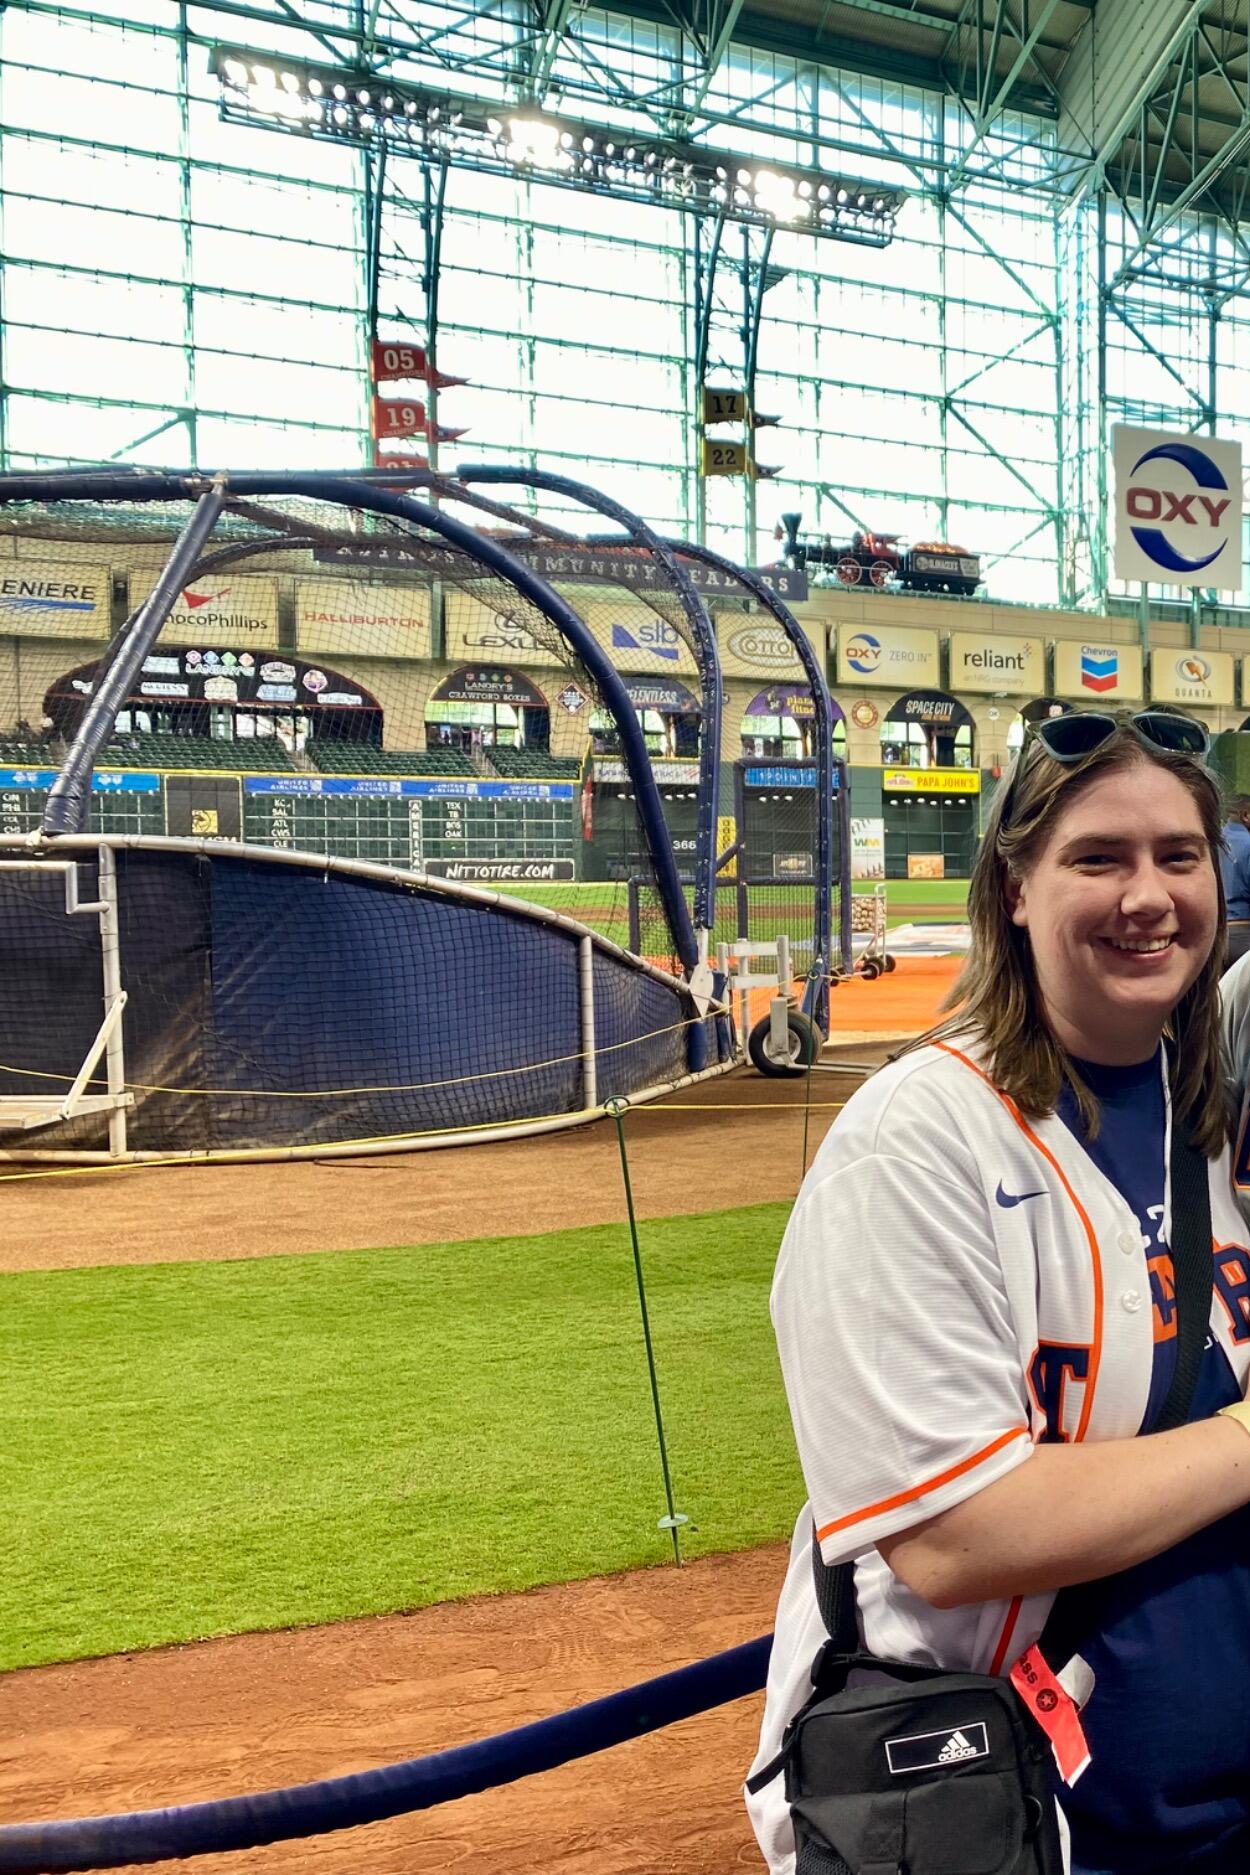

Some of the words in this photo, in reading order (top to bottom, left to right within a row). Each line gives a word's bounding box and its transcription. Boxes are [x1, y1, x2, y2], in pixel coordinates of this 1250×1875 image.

[384, 349, 415, 370] 05
[713, 395, 736, 413] 17
[387, 407, 416, 426] 19
[713, 449, 736, 465] 22
[1126, 487, 1232, 527] OXY
[2, 579, 96, 600] ENIERE
[165, 613, 268, 632] nocoPhillips
[304, 611, 424, 629] HALLIBURTON
[639, 618, 679, 644] slb
[739, 636, 794, 659] COTTO
[846, 648, 881, 659] OXY
[889, 651, 914, 663] ZERO
[1081, 645, 1118, 657] Chevron
[964, 649, 1025, 670] reliant
[465, 682, 513, 691] LANDRY'S
[1175, 687, 1212, 698] QUANTA
[449, 691, 498, 701] CRAWFORD
[906, 700, 934, 715] SPACE
[934, 702, 955, 716] CITY
[917, 777, 940, 787] PAPA
[941, 777, 974, 788] JOHN'S
[446, 801, 461, 810] TEX
[449, 810, 459, 819] TB
[271, 828, 290, 837] CWS
[445, 830, 461, 838] OAK
[274, 840, 288, 848] CLE
[854, 838, 880, 847] WM
[446, 863, 555, 879] NITTOTIRE.COM
[938, 1743, 977, 1762] adidas
